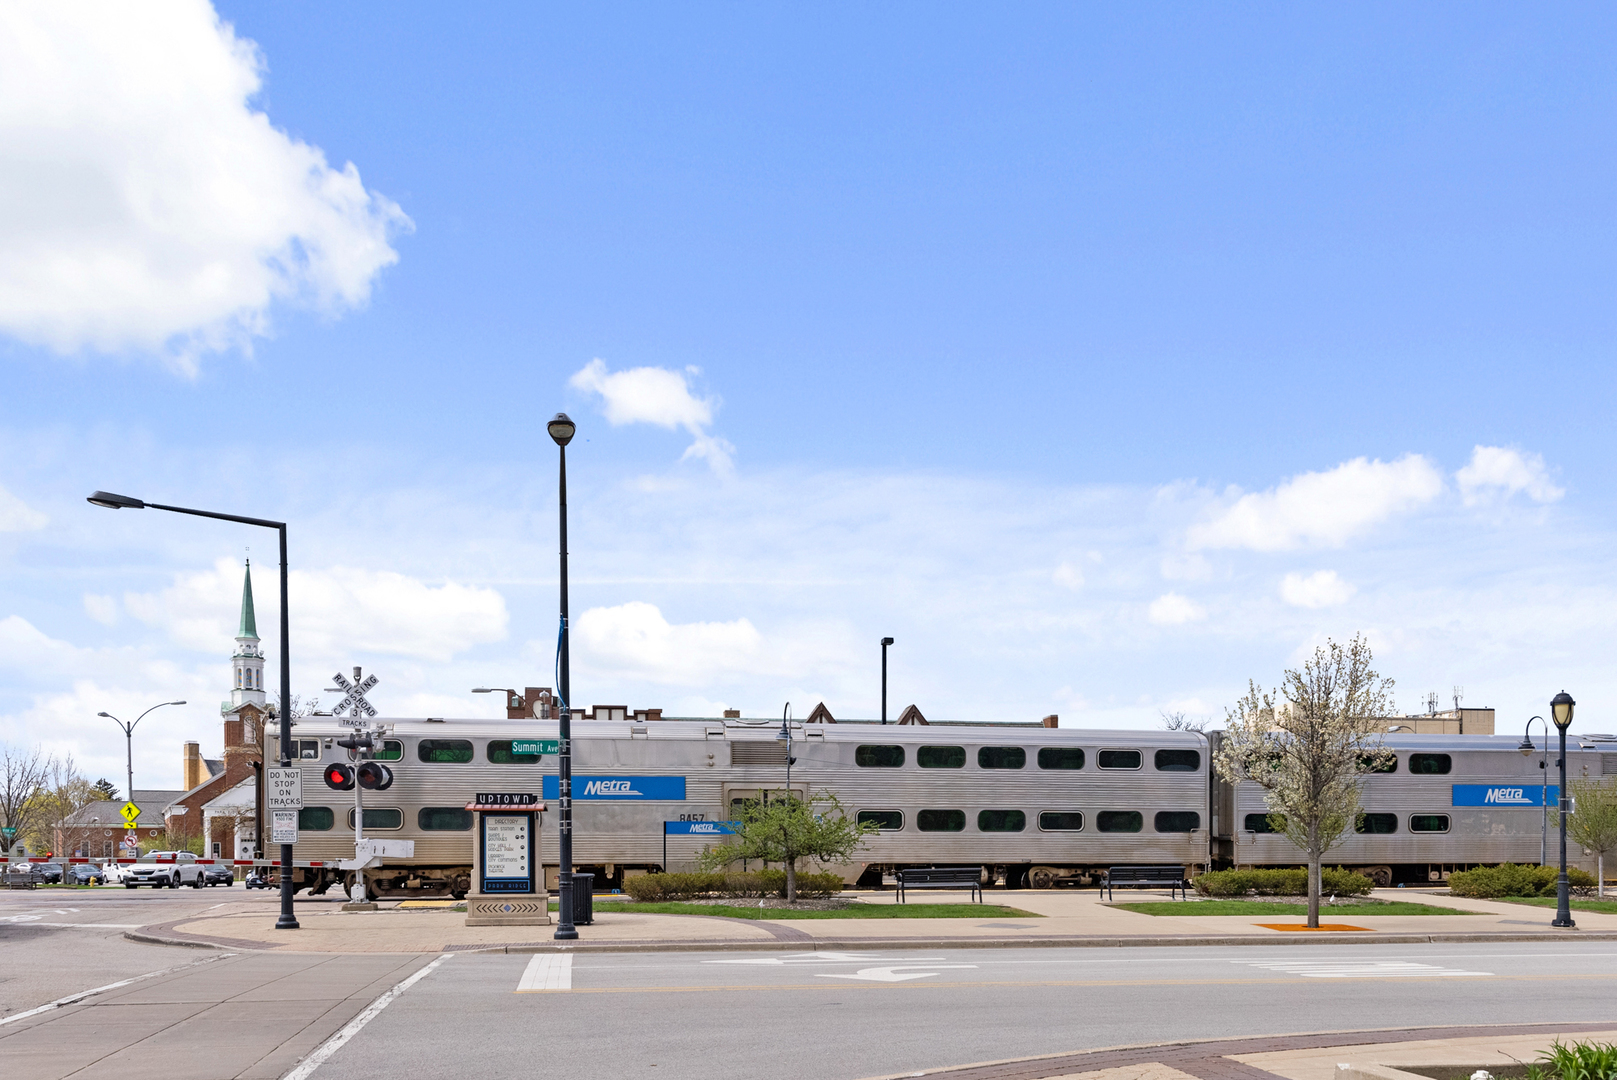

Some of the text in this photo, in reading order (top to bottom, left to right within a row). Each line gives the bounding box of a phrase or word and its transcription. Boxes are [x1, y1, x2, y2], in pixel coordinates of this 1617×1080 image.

[333, 676, 377, 715] CROSSING
[352, 709, 358, 717] 3
[342, 719, 367, 727] TRACKS
[512, 741, 543, 752] Summit
[584, 779, 632, 796] Metra
[479, 795, 529, 803] UPTOWN
[1484, 787, 1524, 803] Metra
[689, 823, 714, 832] Metra
